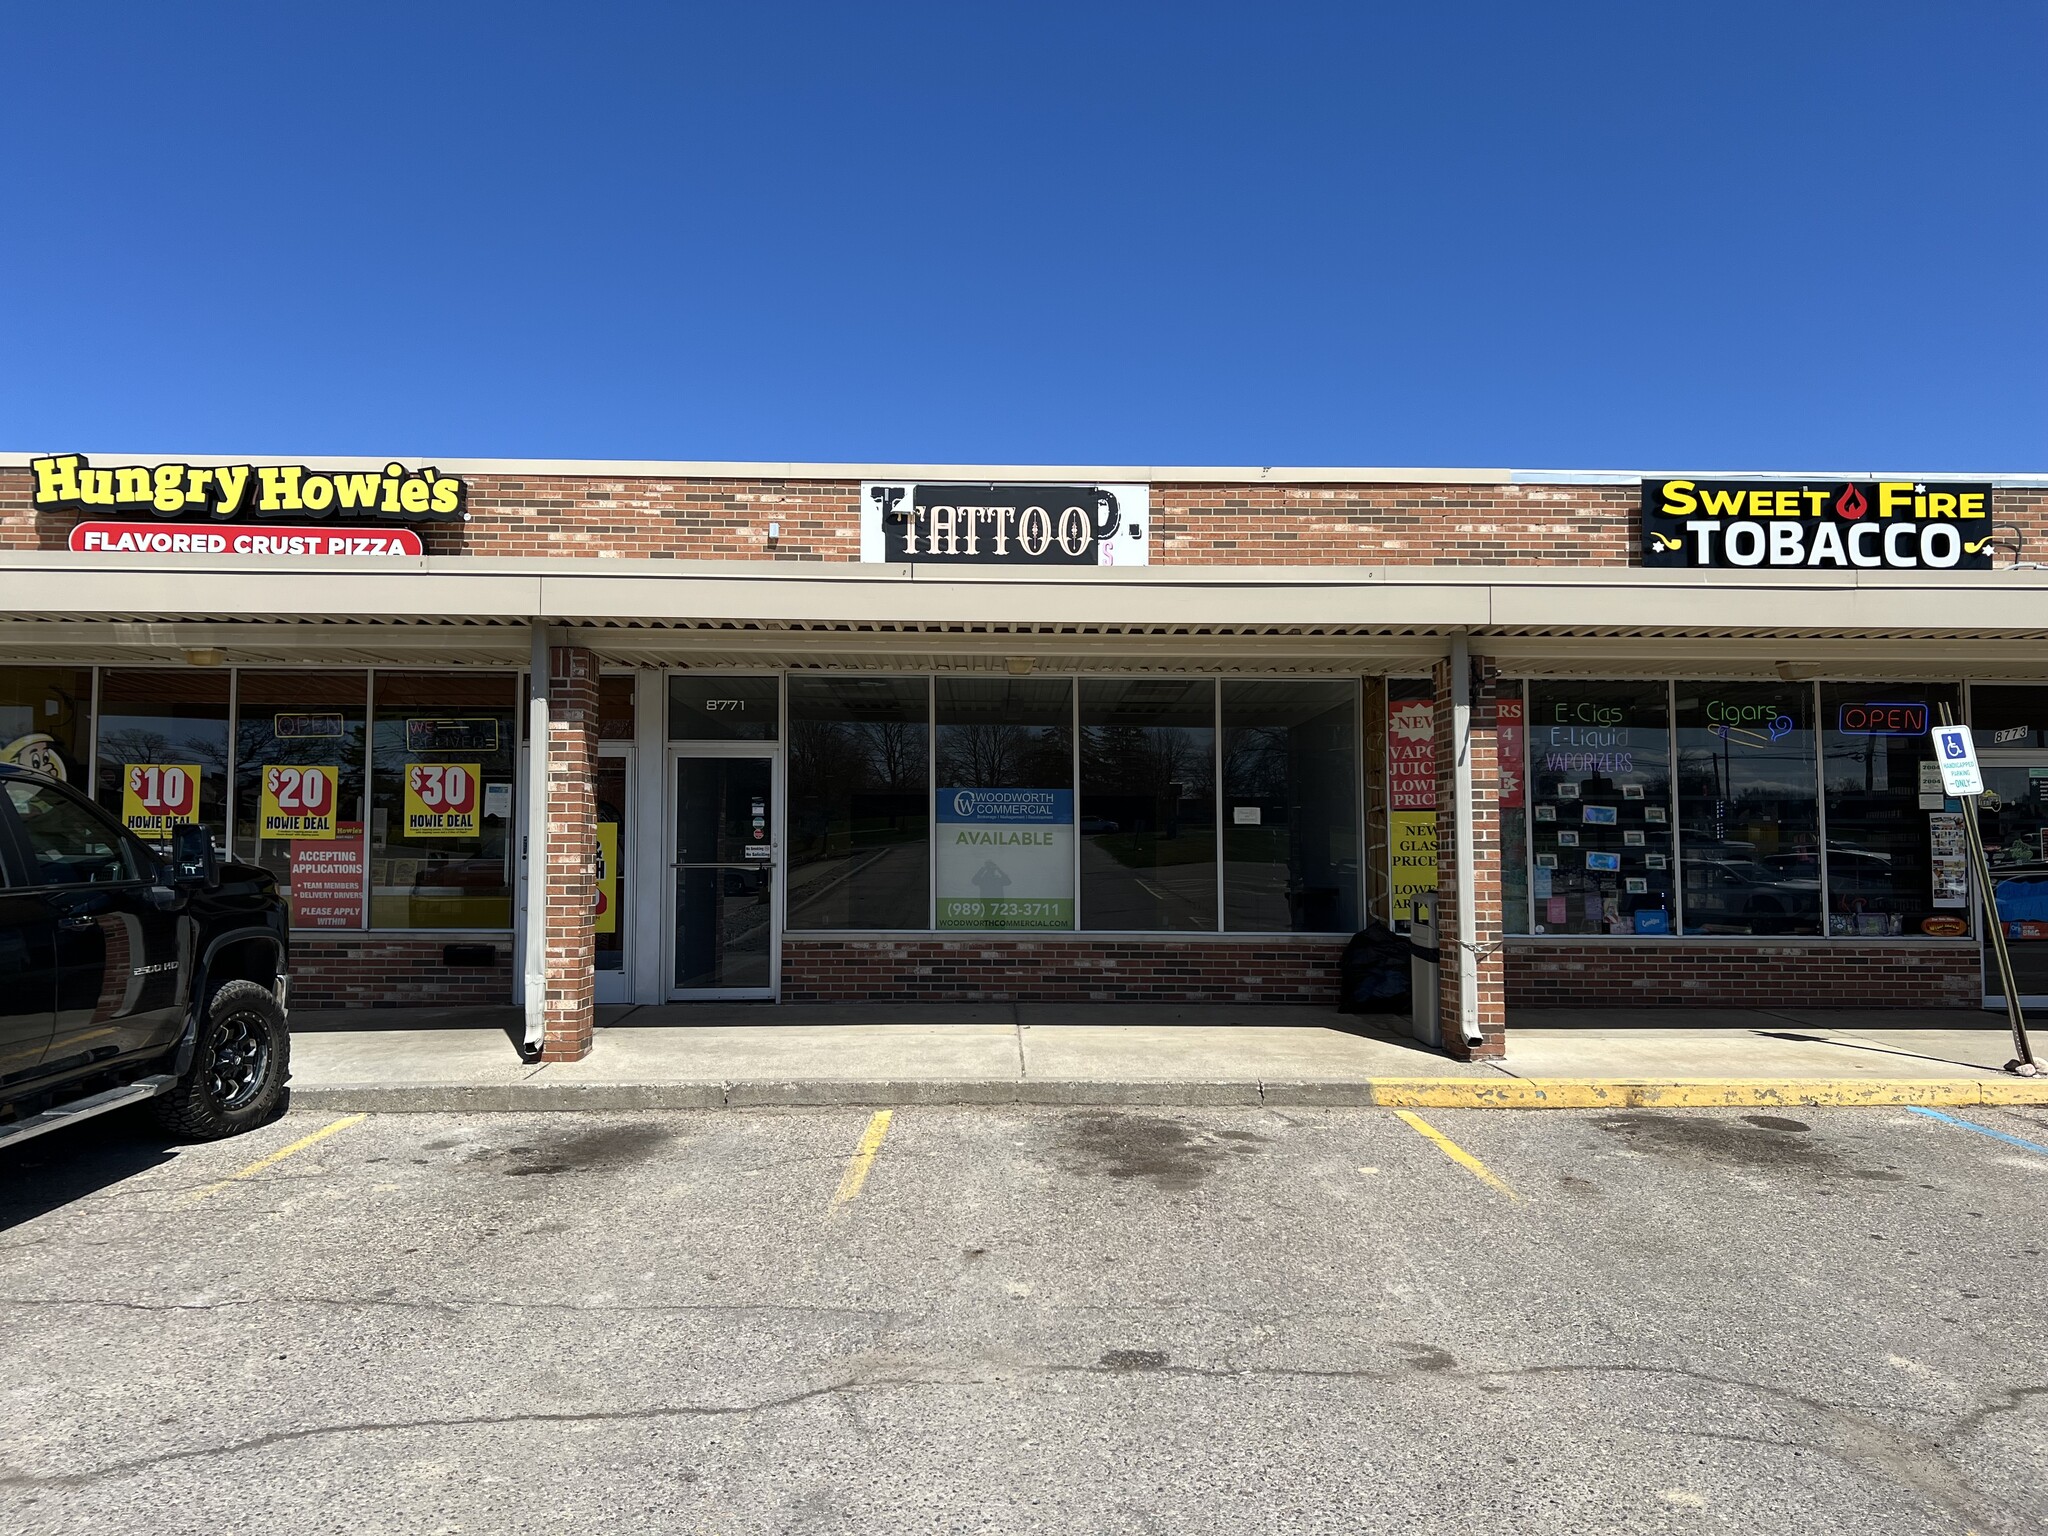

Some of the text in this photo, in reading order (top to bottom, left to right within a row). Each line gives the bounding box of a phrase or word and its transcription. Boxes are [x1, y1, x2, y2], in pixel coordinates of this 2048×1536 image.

[33, 455, 460, 514] Hungry Howie's
[1661, 480, 1831, 517] SWEET
[902, 505, 1094, 557] TATTOO
[84, 531, 407, 556] FLAVORED CRUST PIZZA
[1686, 520, 1961, 568] TOBACCO
[706, 700, 746, 711] 8771
[1555, 702, 1624, 729] E-Cigs
[1706, 701, 1778, 726] Cigars
[1846, 708, 1923, 730] OPEN
[277, 715, 341, 736] OPEN
[410, 721, 436, 735] WE
[1550, 726, 1629, 749] E-Liquid
[1996, 727, 2027, 742] 8773
[1389, 745, 1436, 760] VAPO
[1545, 752, 1633, 773] VAPORIZERS
[1943, 761, 1975, 769] HANDICAPPED
[129, 766, 185, 807] $10
[268, 767, 324, 808] $20
[410, 766, 466, 806] $30
[1391, 779, 1436, 792] LOW
[1954, 779, 1971, 788] ONLY
[975, 792, 1054, 803] WOODWORTH
[976, 804, 1053, 815] COMMERCIAL
[128, 815, 162, 829] HOWIE
[266, 816, 330, 830] HOWIE DEAL
[410, 814, 474, 828] HOWIE DEAL
[955, 831, 1054, 846] AVAILABLE
[1399, 840, 1438, 852] GLAS
[298, 851, 356, 862] ACCEPTING
[292, 864, 363, 874] APPLICATIONS
[323, 882, 359, 890] MEMBERS
[1393, 884, 1438, 895] LOWE
[299, 891, 363, 899] DELIVERY DRIVERS
[300, 907, 361, 916] PLEASE APPLY
[947, 902, 1060, 918] (989) 723-3711
[317, 917, 347, 926] WITHIN
[940, 919, 1069, 927] WOODWORTHCOMMERCIAL.COM
[133, 961, 180, 976] 2500 HD
